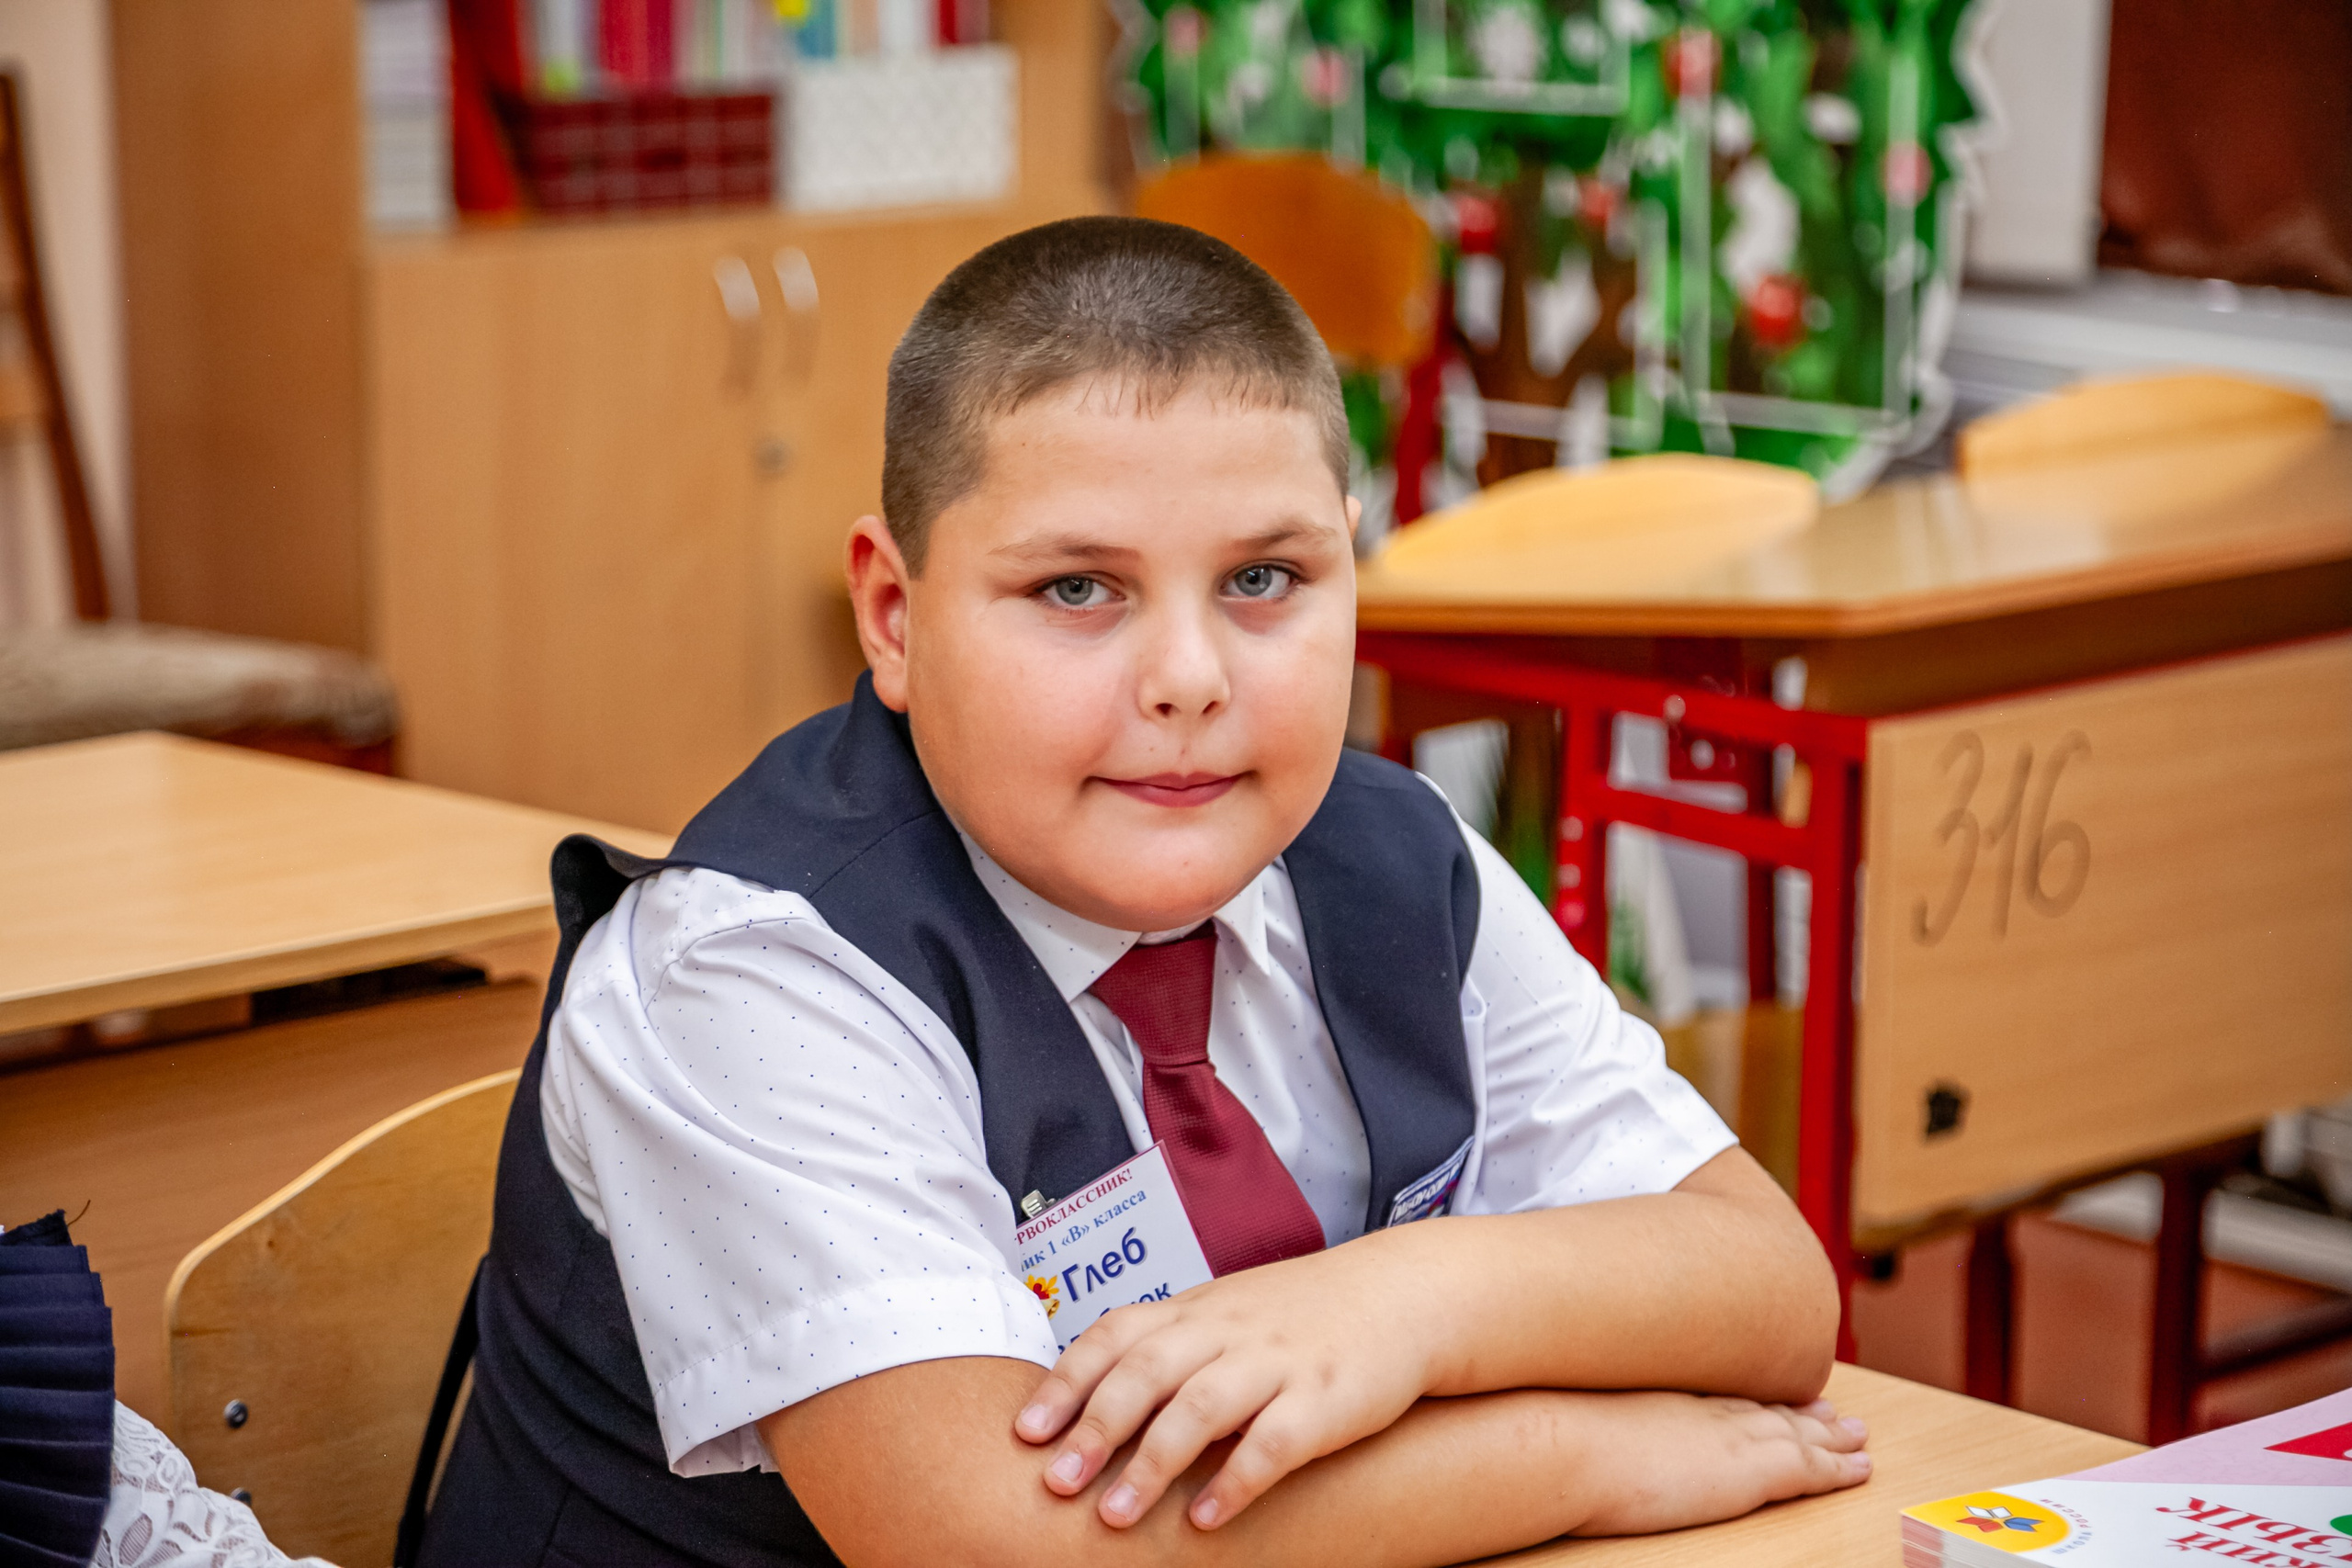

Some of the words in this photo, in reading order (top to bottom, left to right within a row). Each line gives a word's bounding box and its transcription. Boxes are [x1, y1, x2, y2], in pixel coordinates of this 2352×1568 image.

[1910, 728, 2092, 948] 316
[1021, 1250, 1046, 1272] ик
[1048, 1239, 1057, 1256] 1
[1061, 1224, 1091, 1247] «В»
[1093, 1190, 1148, 1229] класса
[1061, 1226, 1147, 1303] Глеб
[2039, 1498, 2092, 1529] РОССИИ
[2155, 1496, 2352, 1562] ЗЫК
